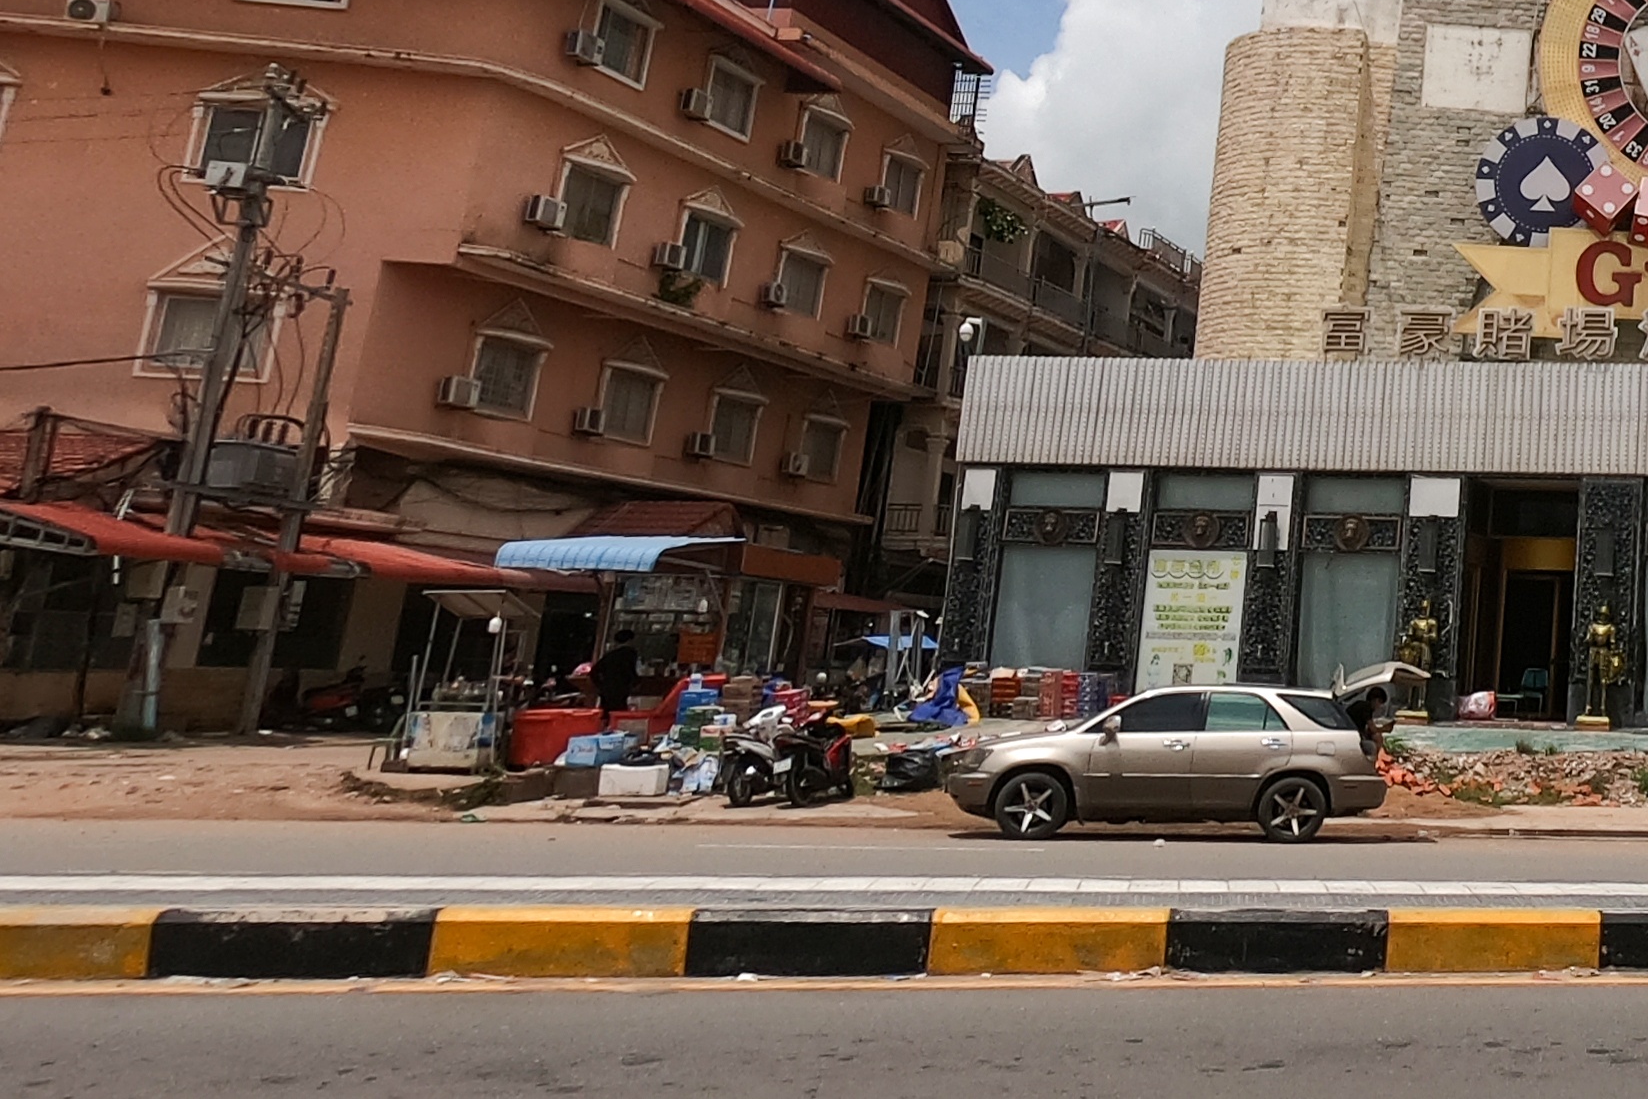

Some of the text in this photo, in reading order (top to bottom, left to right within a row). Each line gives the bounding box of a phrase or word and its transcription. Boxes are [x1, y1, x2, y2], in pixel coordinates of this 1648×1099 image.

[1590, 7, 1607, 24] 29
[1584, 24, 1600, 40] 18
[1582, 43, 1597, 58] 22
[1585, 80, 1600, 94] 31
[1599, 112, 1617, 130] 20
[1625, 140, 1643, 158] 33
